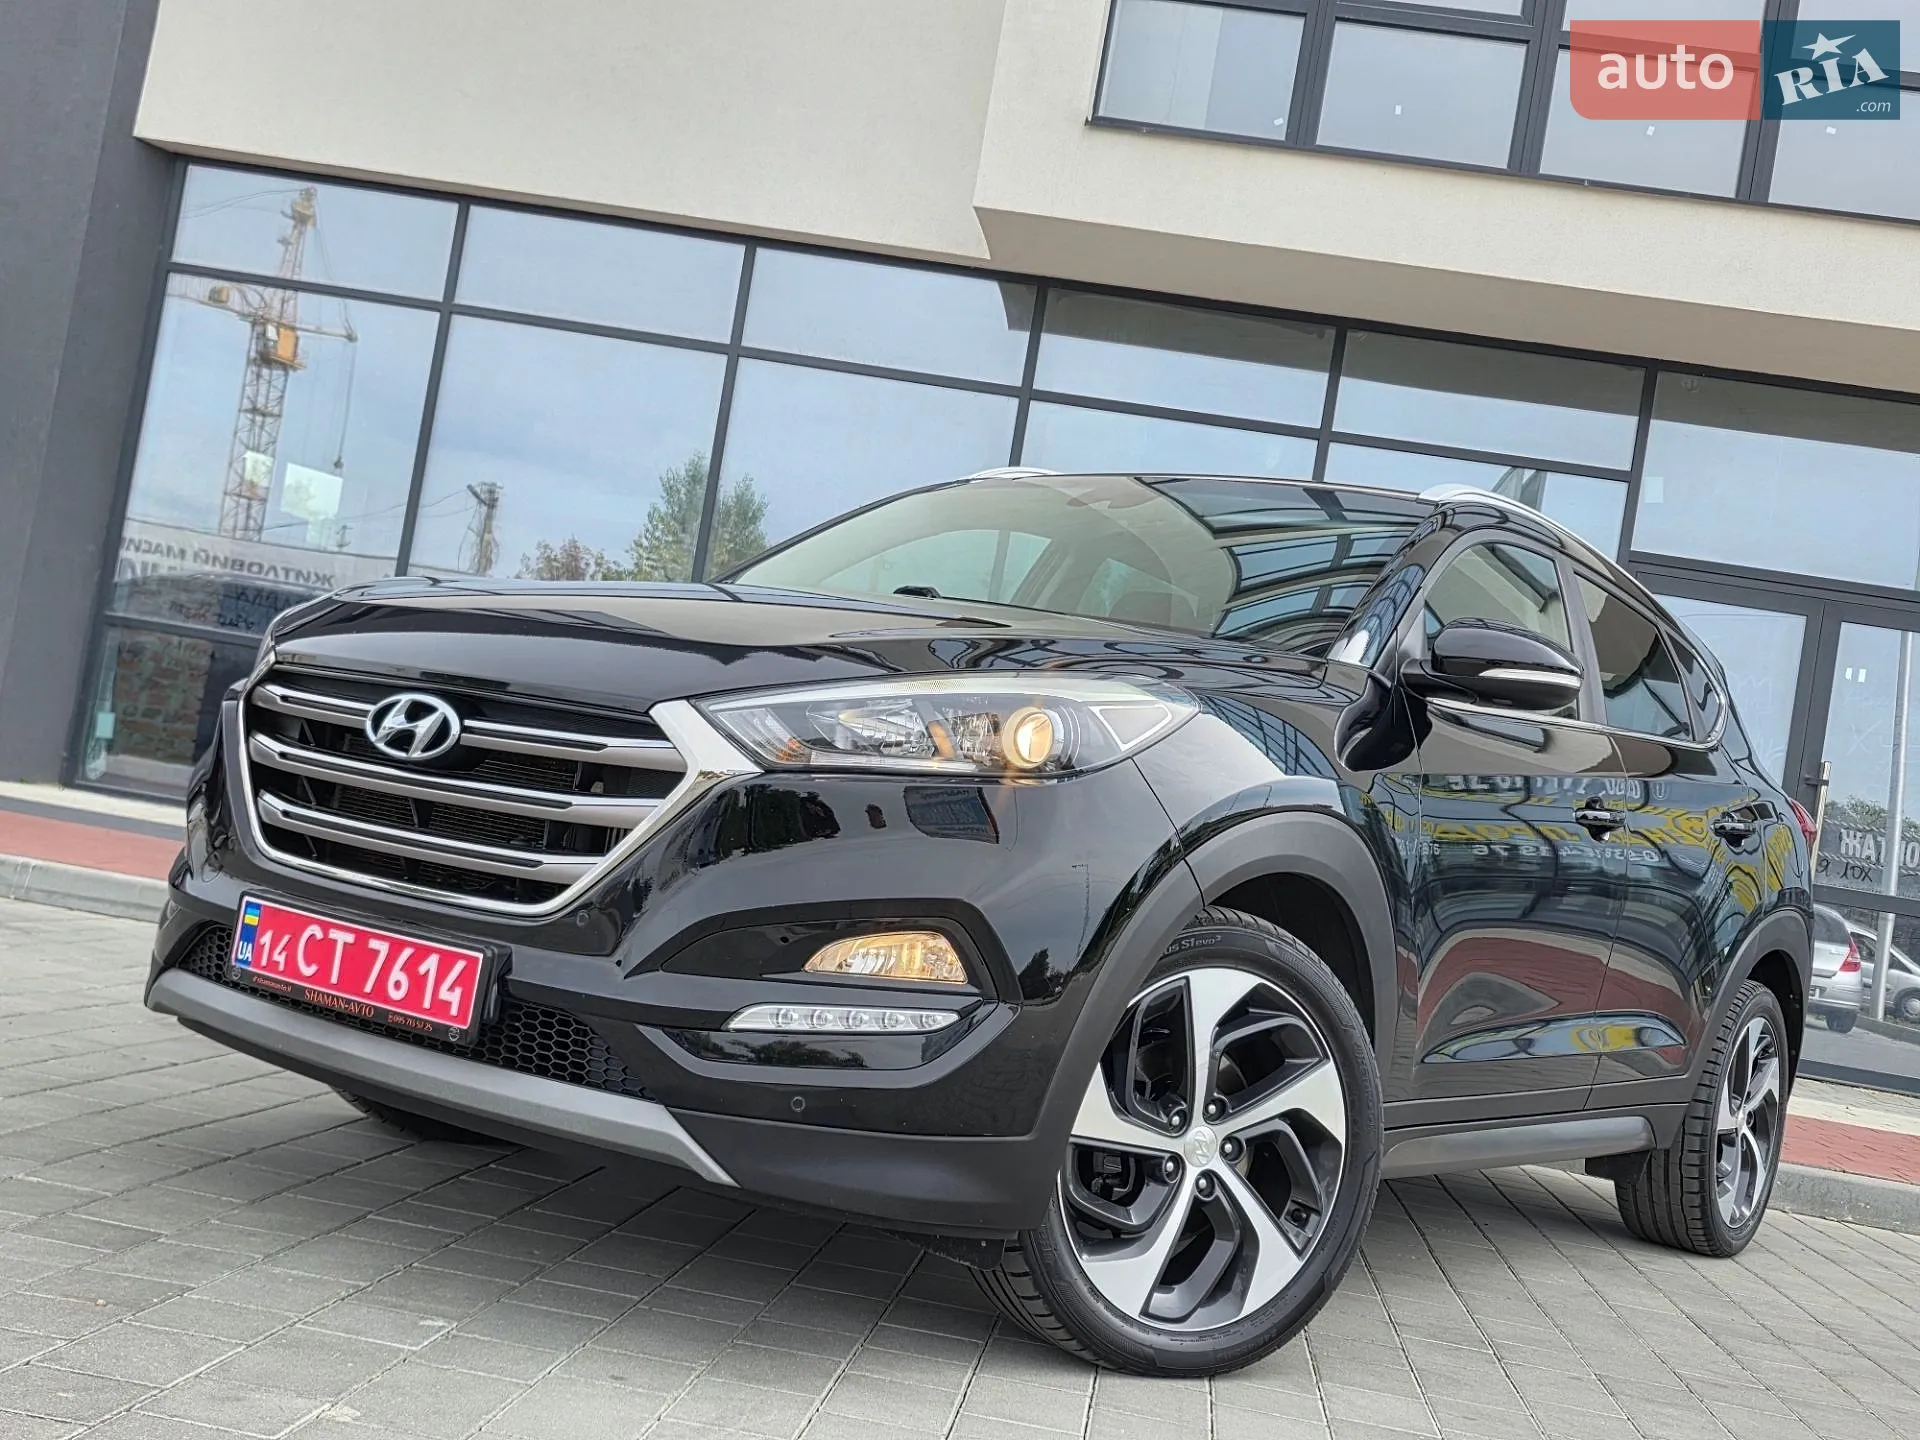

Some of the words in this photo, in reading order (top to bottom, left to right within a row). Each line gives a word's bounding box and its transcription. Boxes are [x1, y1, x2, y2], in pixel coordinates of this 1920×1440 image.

[237, 940, 253, 962] UA
[259, 929, 292, 972] 14
[297, 924, 356, 985] CT
[363, 938, 469, 1017] 7614
[304, 988, 375, 1018] SHAMAN-AVTO
